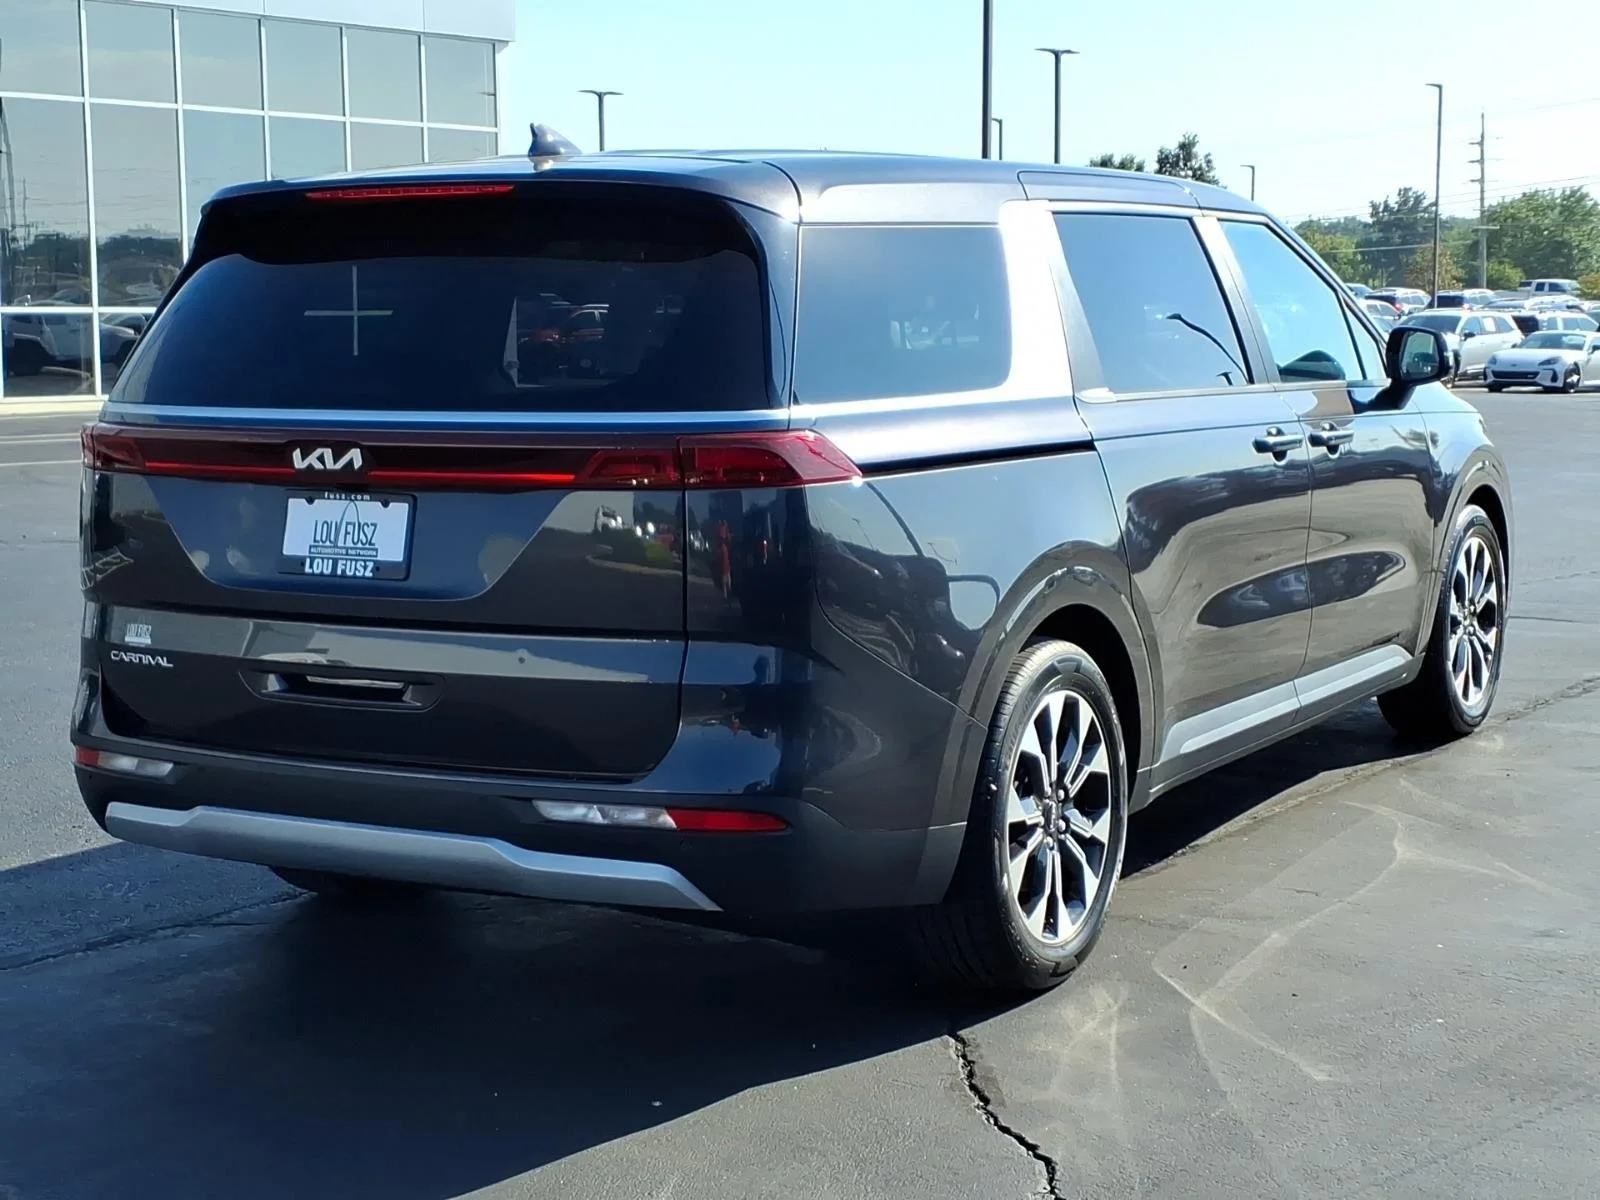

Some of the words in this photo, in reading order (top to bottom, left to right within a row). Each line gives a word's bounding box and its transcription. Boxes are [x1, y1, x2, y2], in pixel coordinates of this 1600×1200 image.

[292, 447, 363, 470] KIA
[313, 519, 339, 544] LOU
[343, 521, 378, 546] FUSZ
[347, 548, 377, 556] NETWORK
[304, 557, 332, 574] LOU
[336, 559, 375, 577] FUSZ
[110, 650, 174, 667] CARNIVAL
